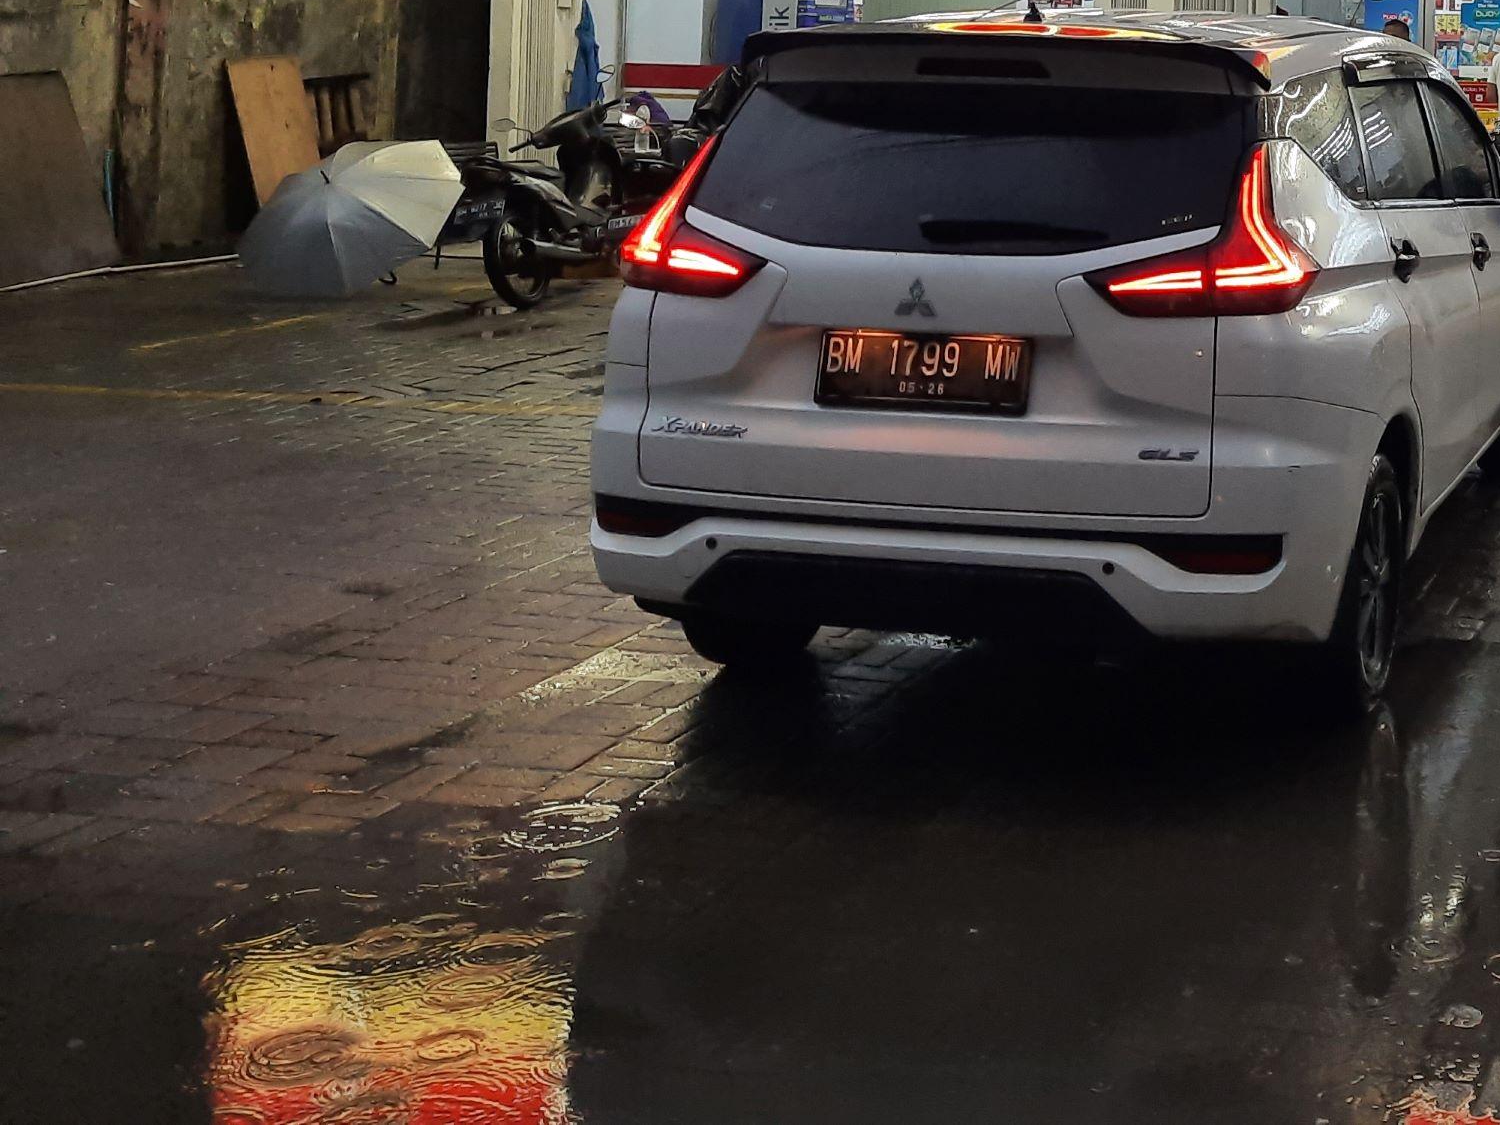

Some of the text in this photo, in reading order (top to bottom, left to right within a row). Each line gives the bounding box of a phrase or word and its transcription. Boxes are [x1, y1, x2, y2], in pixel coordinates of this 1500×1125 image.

[826, 337, 1022, 381] BM 1799 MW
